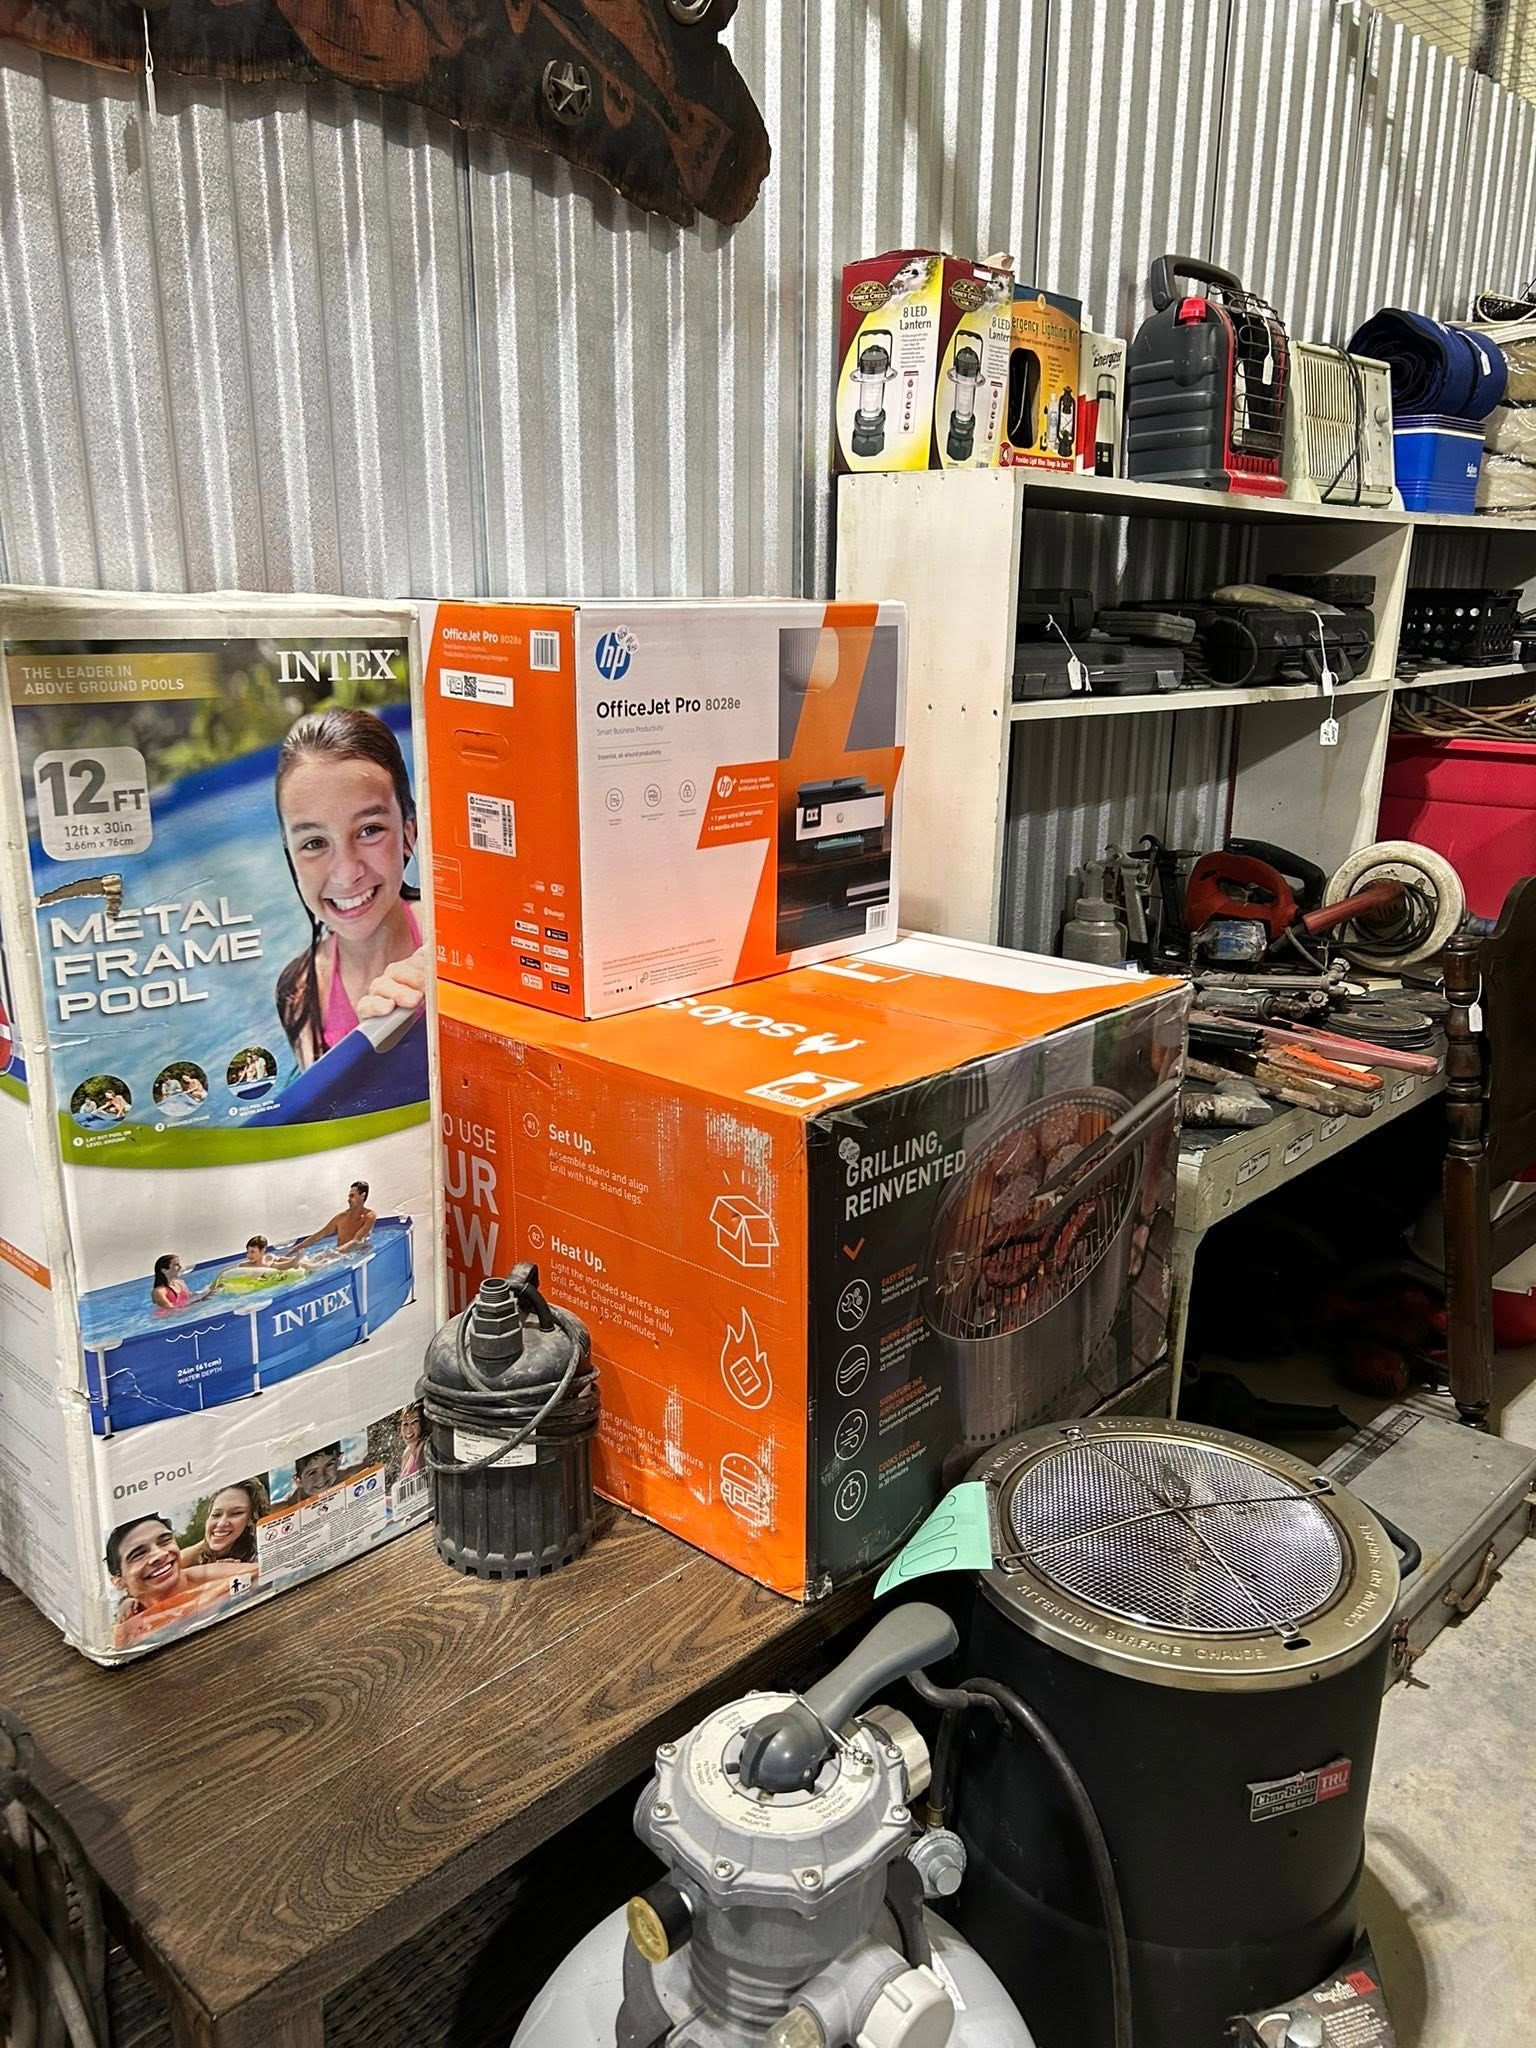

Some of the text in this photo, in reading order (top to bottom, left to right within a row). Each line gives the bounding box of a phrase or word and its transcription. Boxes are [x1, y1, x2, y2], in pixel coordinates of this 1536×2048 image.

[900, 320, 932, 330] Lantern
[903, 306, 928, 318] 8 LED
[991, 316, 1010, 330] 8 LED
[1041, 320, 1067, 342] Lighting
[442, 628, 481, 642] OfficeJet
[482, 630, 499, 644] Pro
[22, 665, 133, 680] THE LEADER IN
[276, 649, 397, 683] INTEX
[598, 632, 630, 681] hp
[24, 678, 185, 695] ABOVE GROUND POOLS
[596, 697, 741, 719] OfficeJet Pro 8028e
[613, 727, 636, 735] Business
[39, 758, 146, 817] 12 FT
[64, 821, 132, 838] 12ft x 30in
[65, 837, 134, 851] 3.66m x 76cm
[50, 897, 253, 948] METAL
[54, 929, 263, 987] FRAME
[58, 977, 209, 1021] POOL
[459, 1118, 497, 1155] USE
[549, 1123, 596, 1155] Set Up.
[549, 1147, 649, 1194] Assemble stand and align
[846, 1130, 943, 1187] GRILLING,
[550, 1162, 645, 1206] Grill with the stand legs.
[845, 1149, 966, 1221] REINVENTED
[551, 1235, 607, 1273] Heat Up.
[551, 1259, 670, 1319] Light the included starters and
[551, 1272, 674, 1337] Grill Pack. Charcoal will be fully
[273, 1285, 353, 1337] INTEX
[551, 1287, 659, 1342] preheated in 15-20 minutes.
[178, 1367, 195, 1377] 24in
[178, 1373, 201, 1384] WATER
[600, 1408, 662, 1447] get grilling! Our
[113, 1461, 193, 1500] One Pool
[1016, 1584, 1268, 1662] ATTENTION SURFACE CHAUDE
[1343, 1589, 1379, 1628] CAUTION
[1322, 1769, 1348, 1789] TRU
